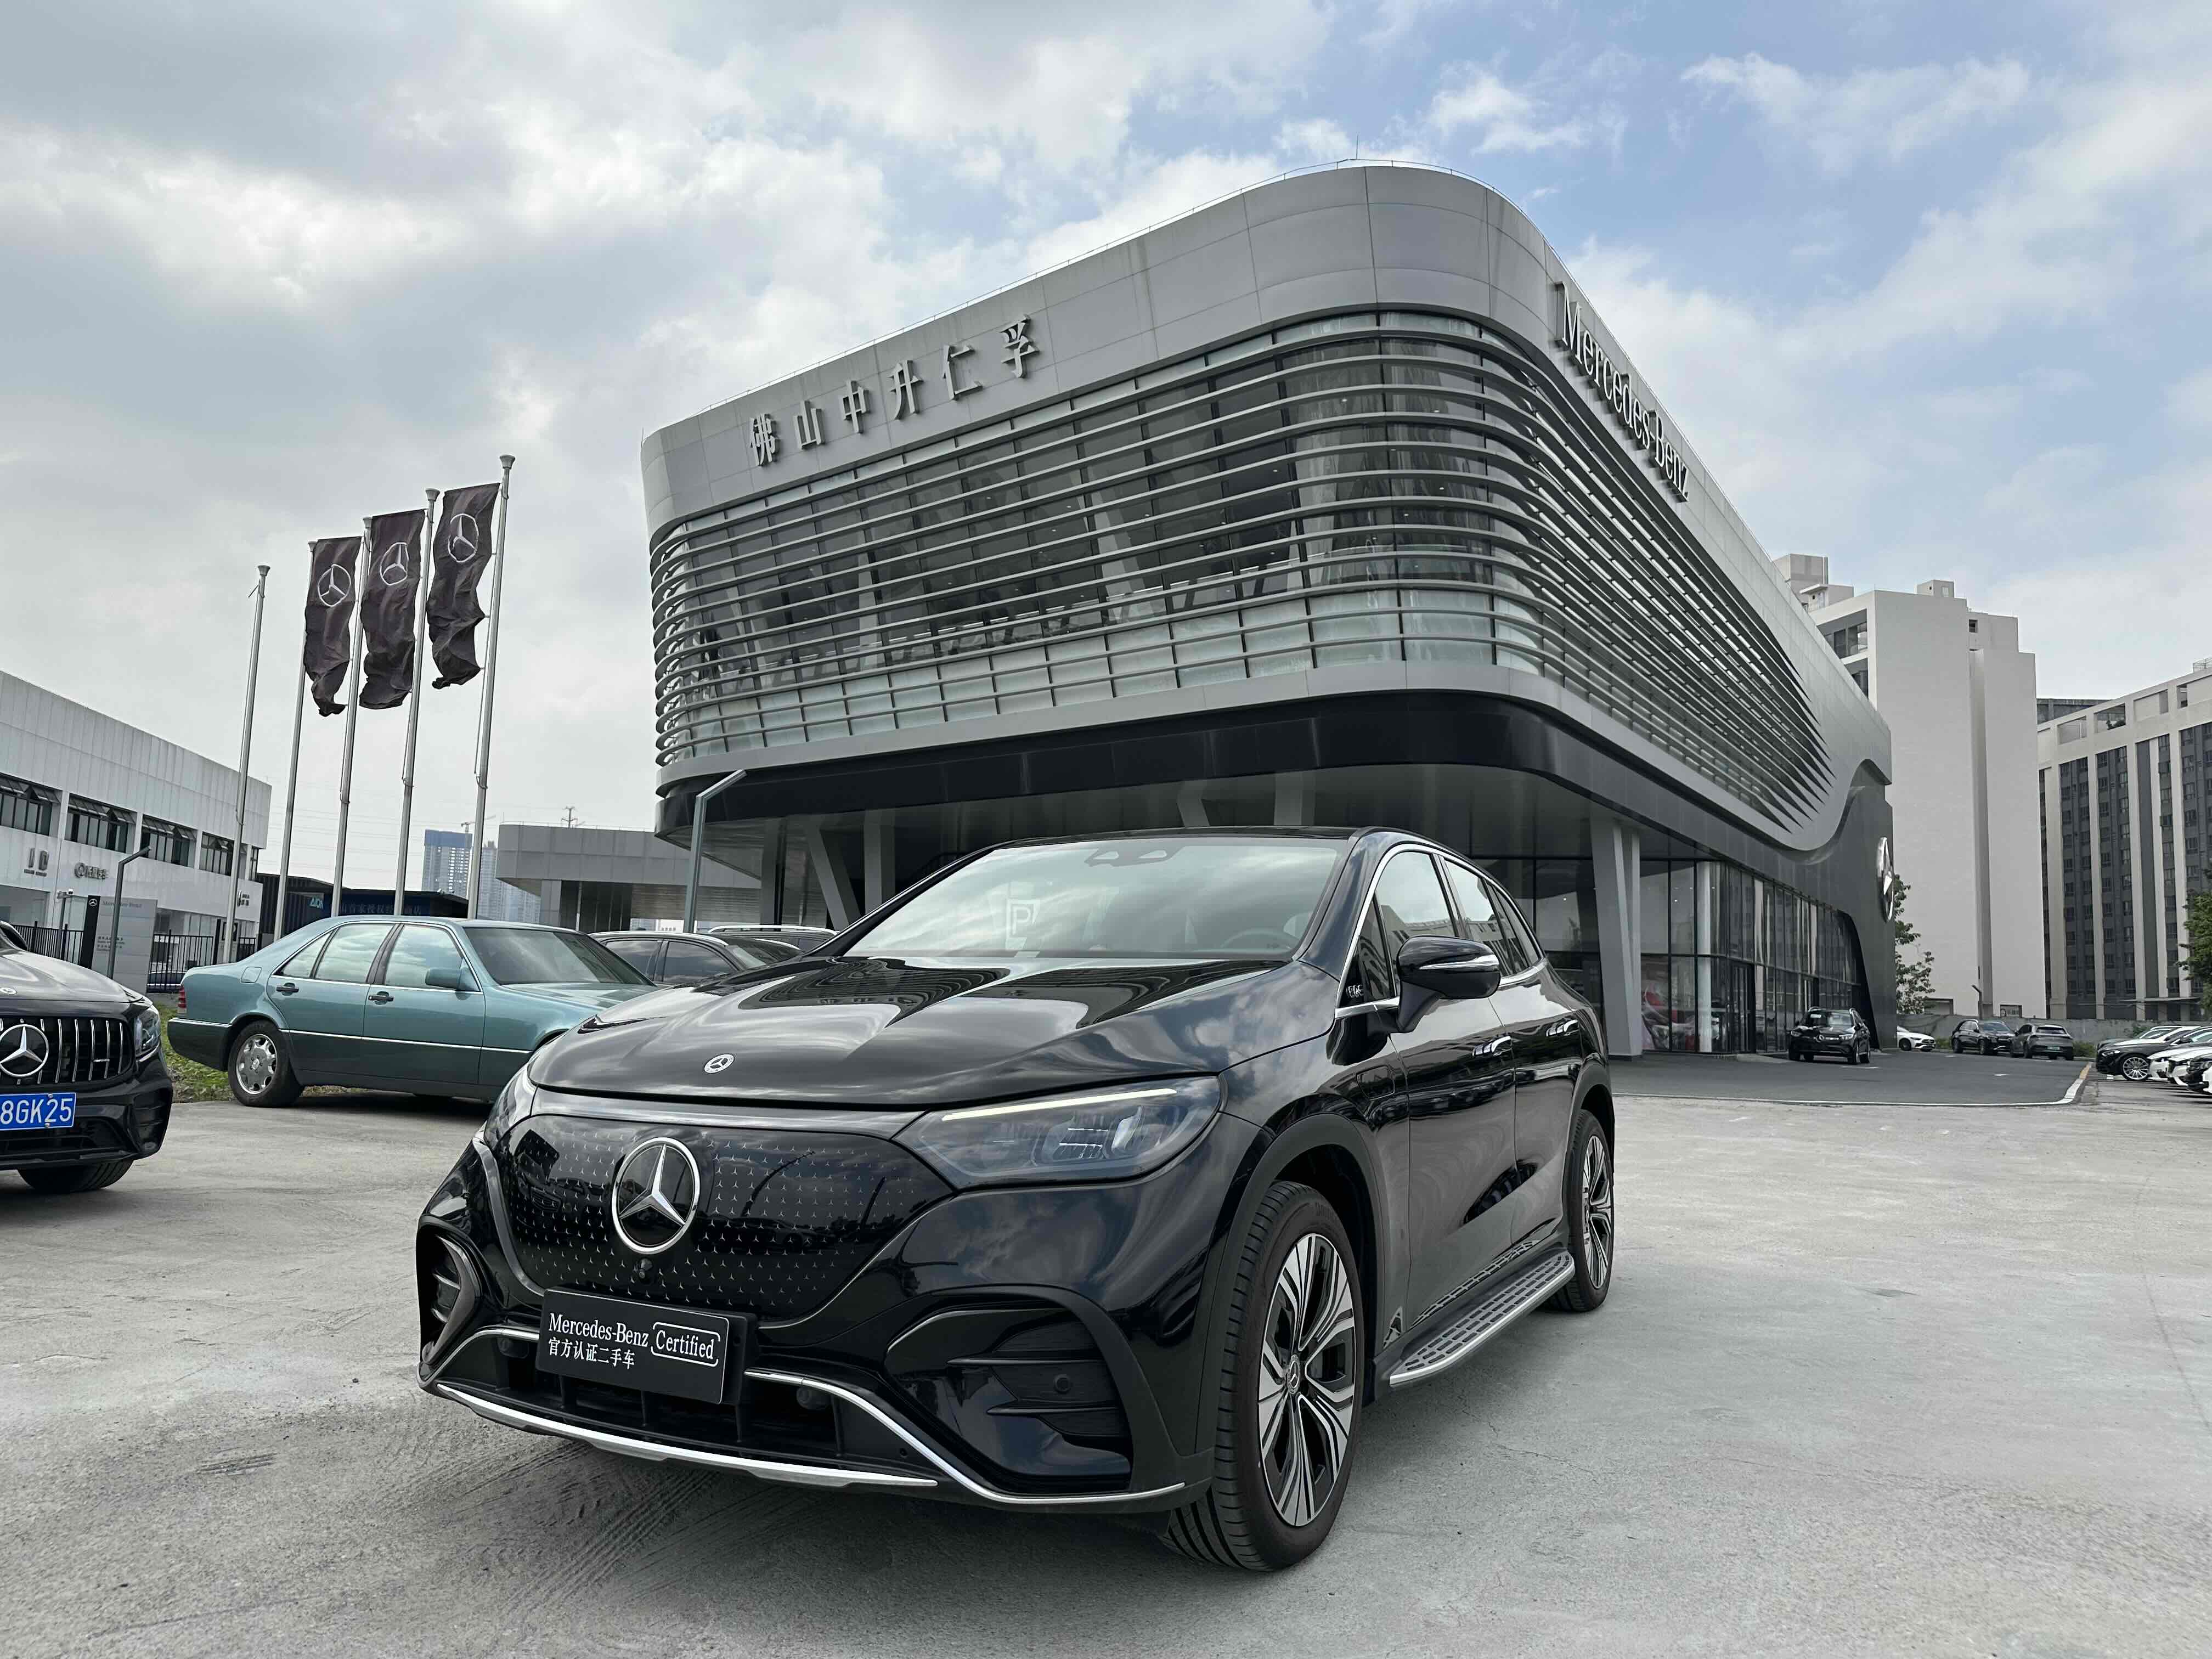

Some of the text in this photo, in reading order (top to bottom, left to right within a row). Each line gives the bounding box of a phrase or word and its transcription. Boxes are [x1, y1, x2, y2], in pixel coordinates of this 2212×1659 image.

[750, 314, 1040, 467] 佛山中升仁孚
[1555, 281, 1689, 502] Mercedes-Benz
[1012, 906, 1031, 935] P
[0, 1098, 73, 1124] 8GK25
[548, 1337, 636, 1370] 官方认证二手车
[549, 1313, 714, 1360] Mercedes-Benz Certified
